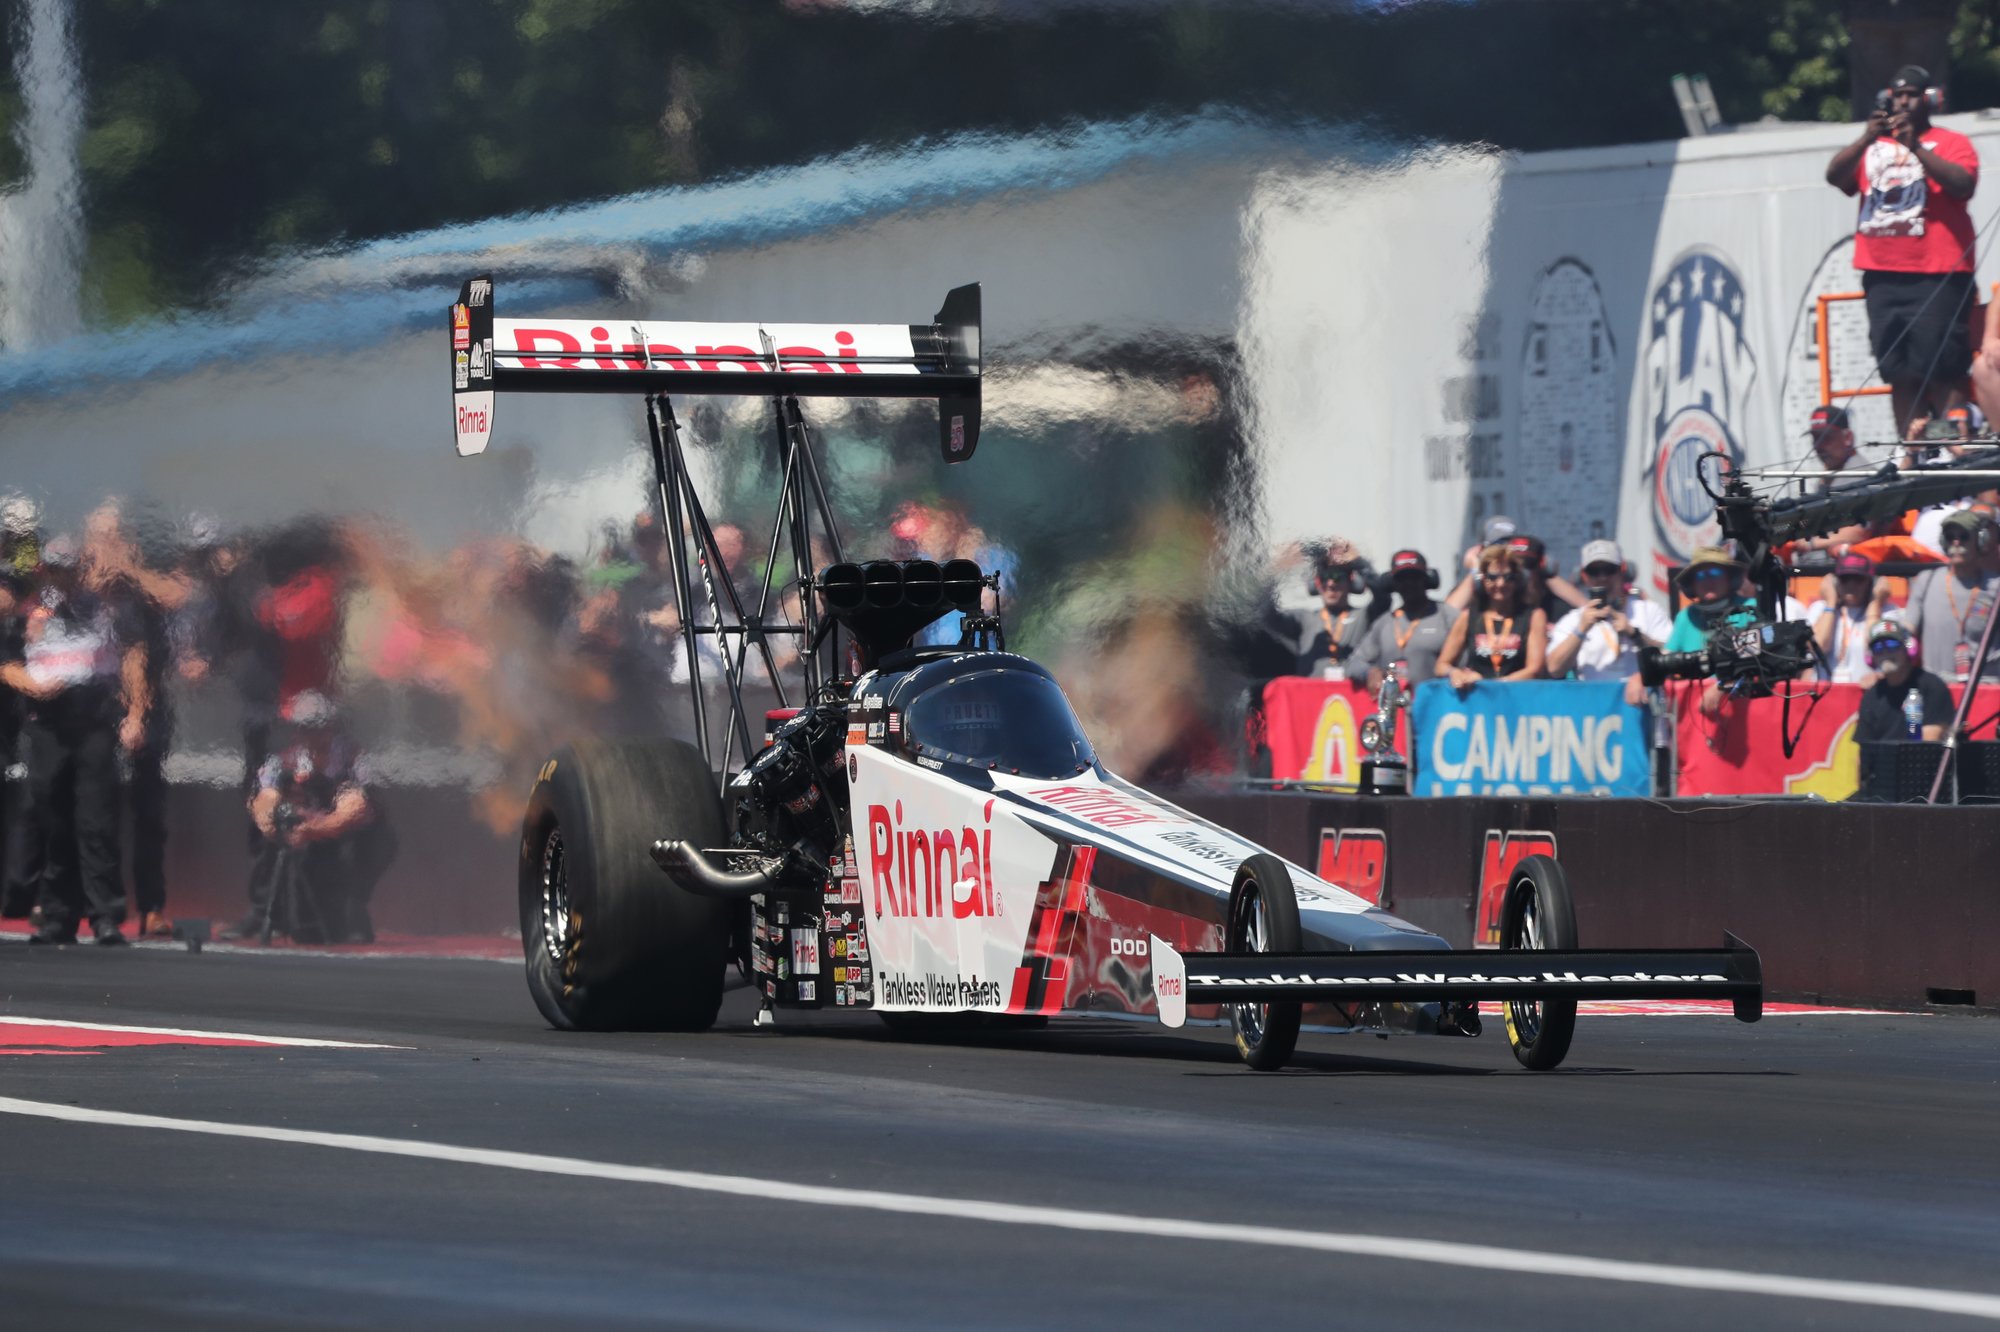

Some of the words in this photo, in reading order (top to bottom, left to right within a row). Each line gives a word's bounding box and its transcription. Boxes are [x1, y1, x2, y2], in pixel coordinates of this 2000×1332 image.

[459, 404, 487, 434] Rinnai
[1432, 712, 1624, 784] CAMPING
[1028, 786, 1190, 828] Rinnai
[868, 798, 996, 919] Rinnai
[794, 939, 817, 964] Rinnai
[847, 967, 861, 981] ARP
[879, 971, 926, 1006] Tankless
[925, 972, 957, 1007] Water
[1158, 973, 1182, 997] Rinnai
[1188, 973, 1396, 985] Tankless
[1396, 972, 1537, 984] Water
[1542, 971, 1729, 983] Heaters
